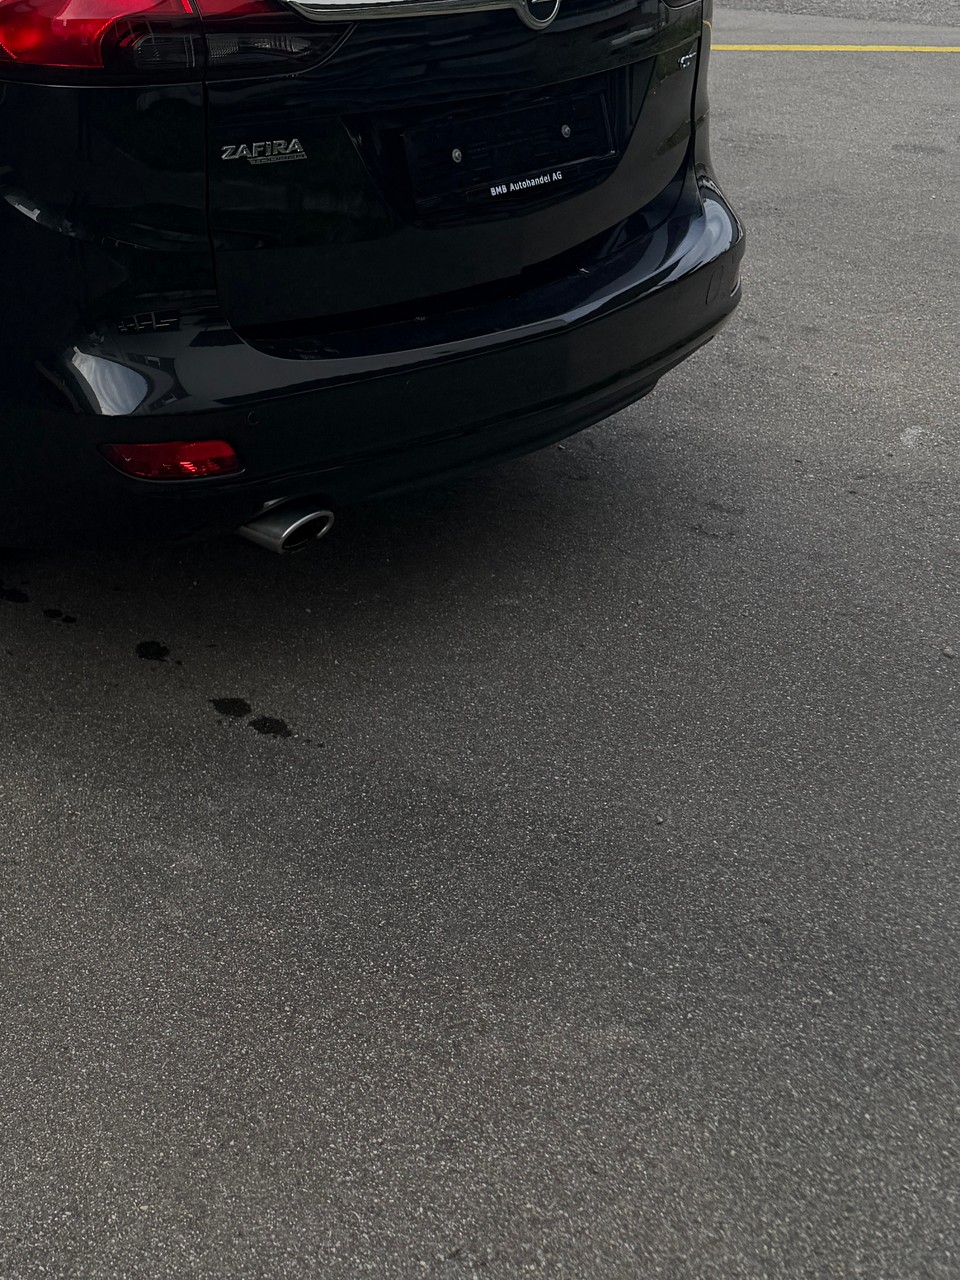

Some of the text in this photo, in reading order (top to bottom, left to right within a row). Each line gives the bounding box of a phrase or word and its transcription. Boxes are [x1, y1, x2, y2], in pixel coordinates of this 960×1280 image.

[221, 138, 304, 160] ZAFIRA
[490, 171, 563, 196] BMB Autohandel AG
